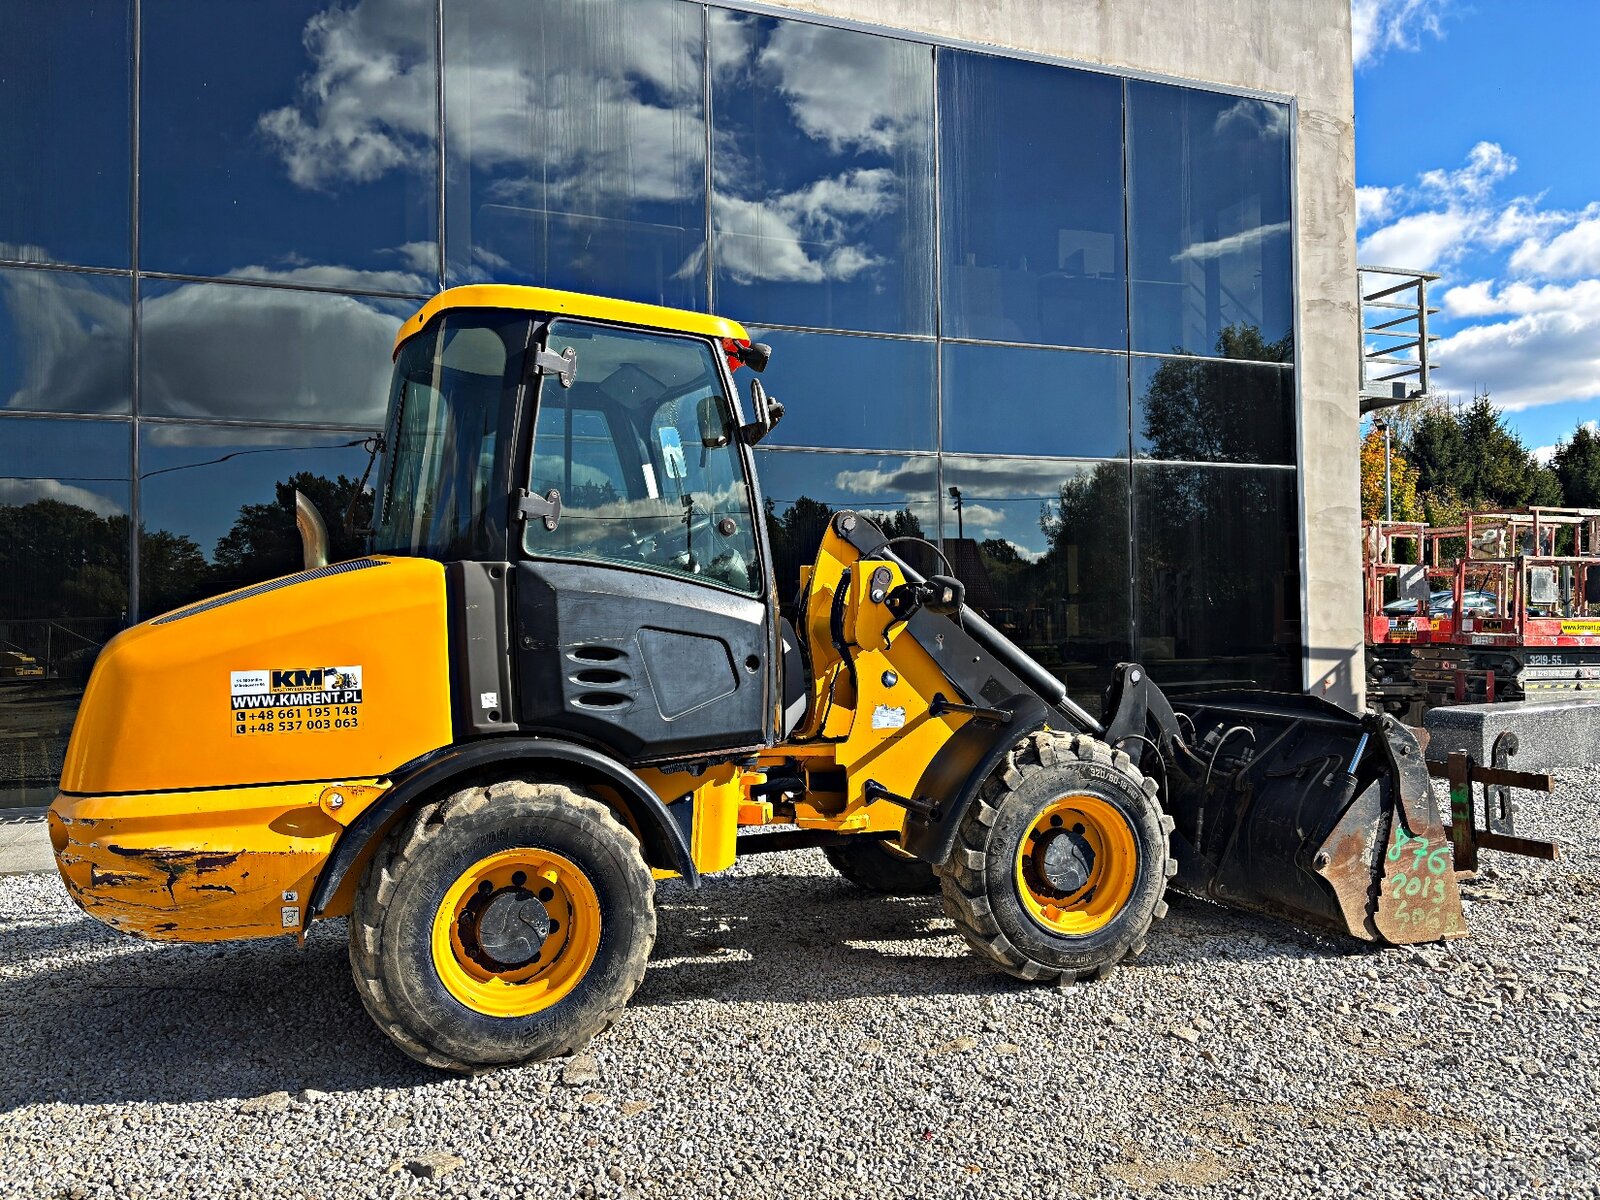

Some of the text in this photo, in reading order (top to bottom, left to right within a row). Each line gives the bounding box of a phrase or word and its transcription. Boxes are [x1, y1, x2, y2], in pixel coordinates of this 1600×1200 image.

[1483, 620, 1501, 629] KM
[272, 669, 323, 688] KM
[232, 691, 361, 709] WWW.KMRENT.PL
[249, 705, 358, 720] +48 661 195 148
[249, 717, 358, 733] +48 537 003 063
[1387, 825, 1449, 875] 876
